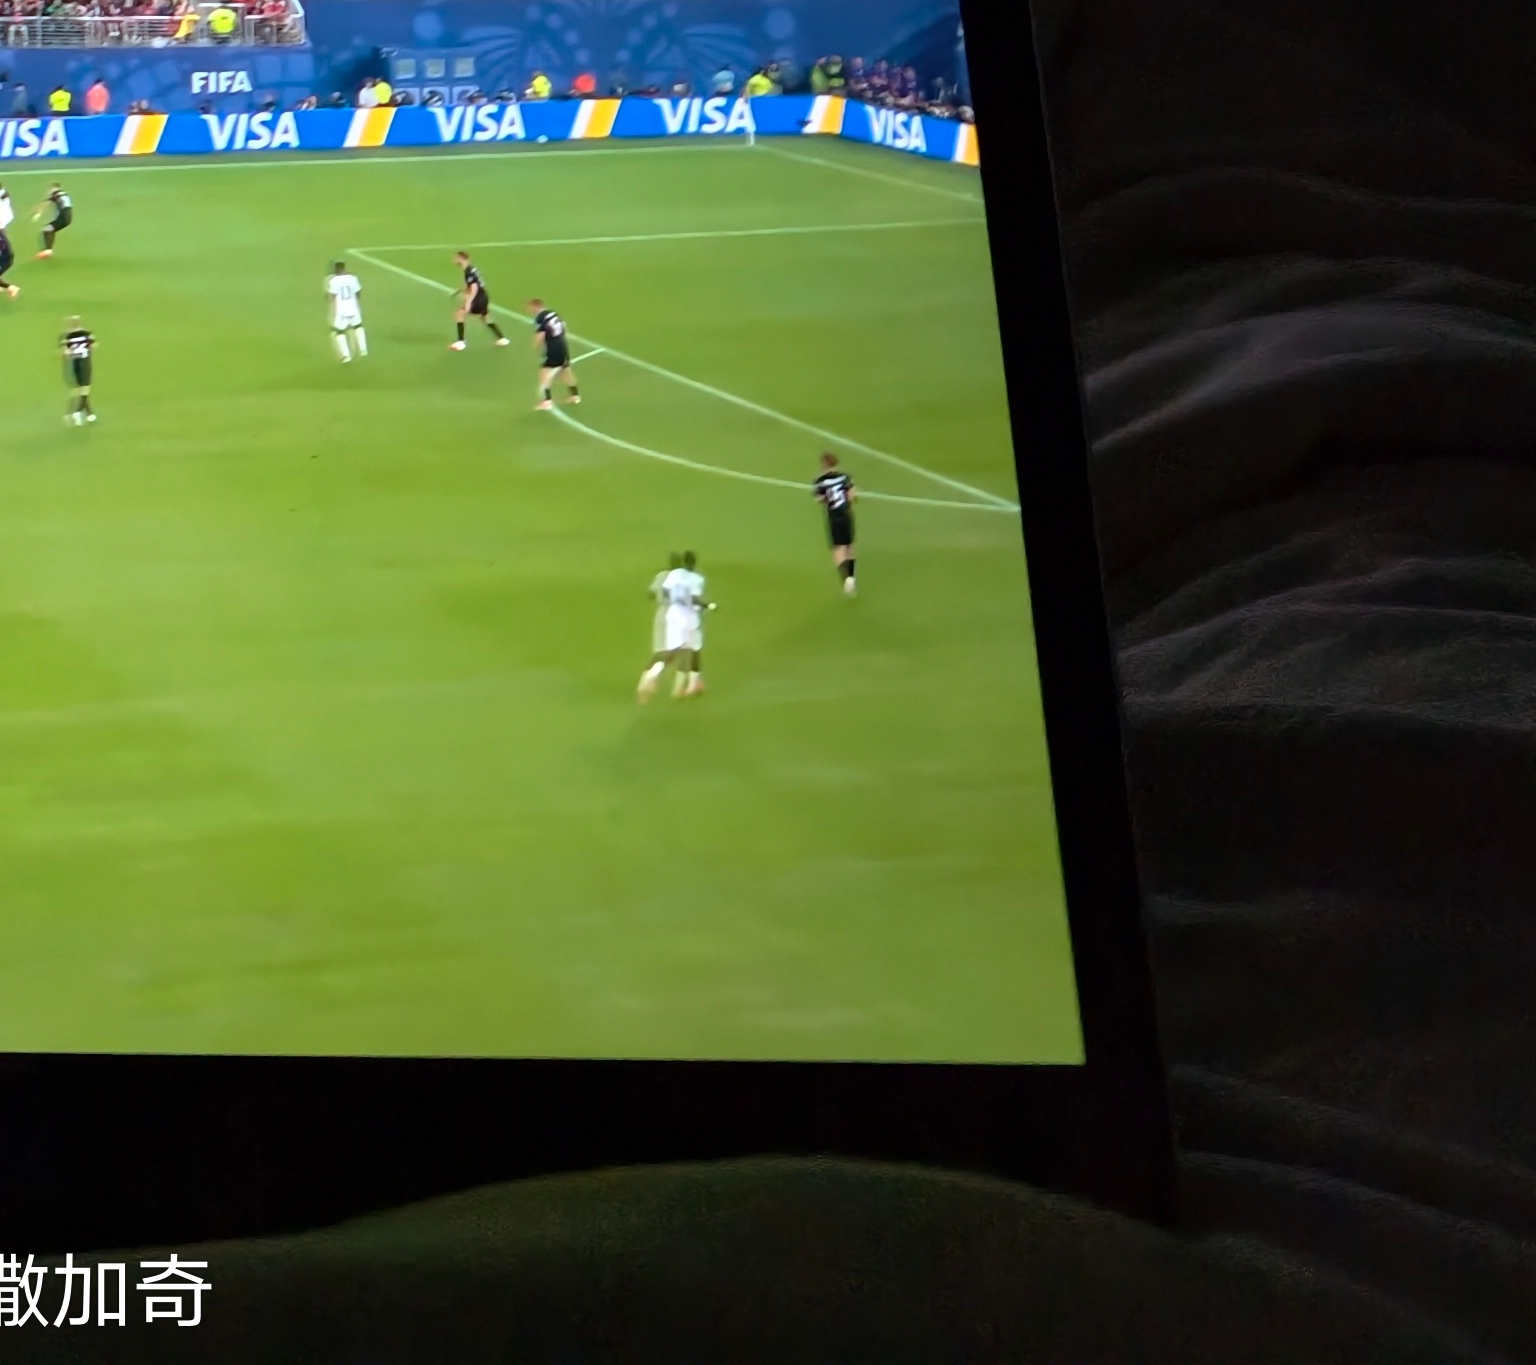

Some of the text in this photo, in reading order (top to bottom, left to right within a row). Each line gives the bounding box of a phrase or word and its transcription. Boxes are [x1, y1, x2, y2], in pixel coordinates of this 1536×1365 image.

[191, 70, 253, 94] FIFA
[206, 111, 300, 150] VISA
[428, 104, 525, 142] VISA
[654, 97, 756, 134] VISA
[866, 105, 927, 153] VISA
